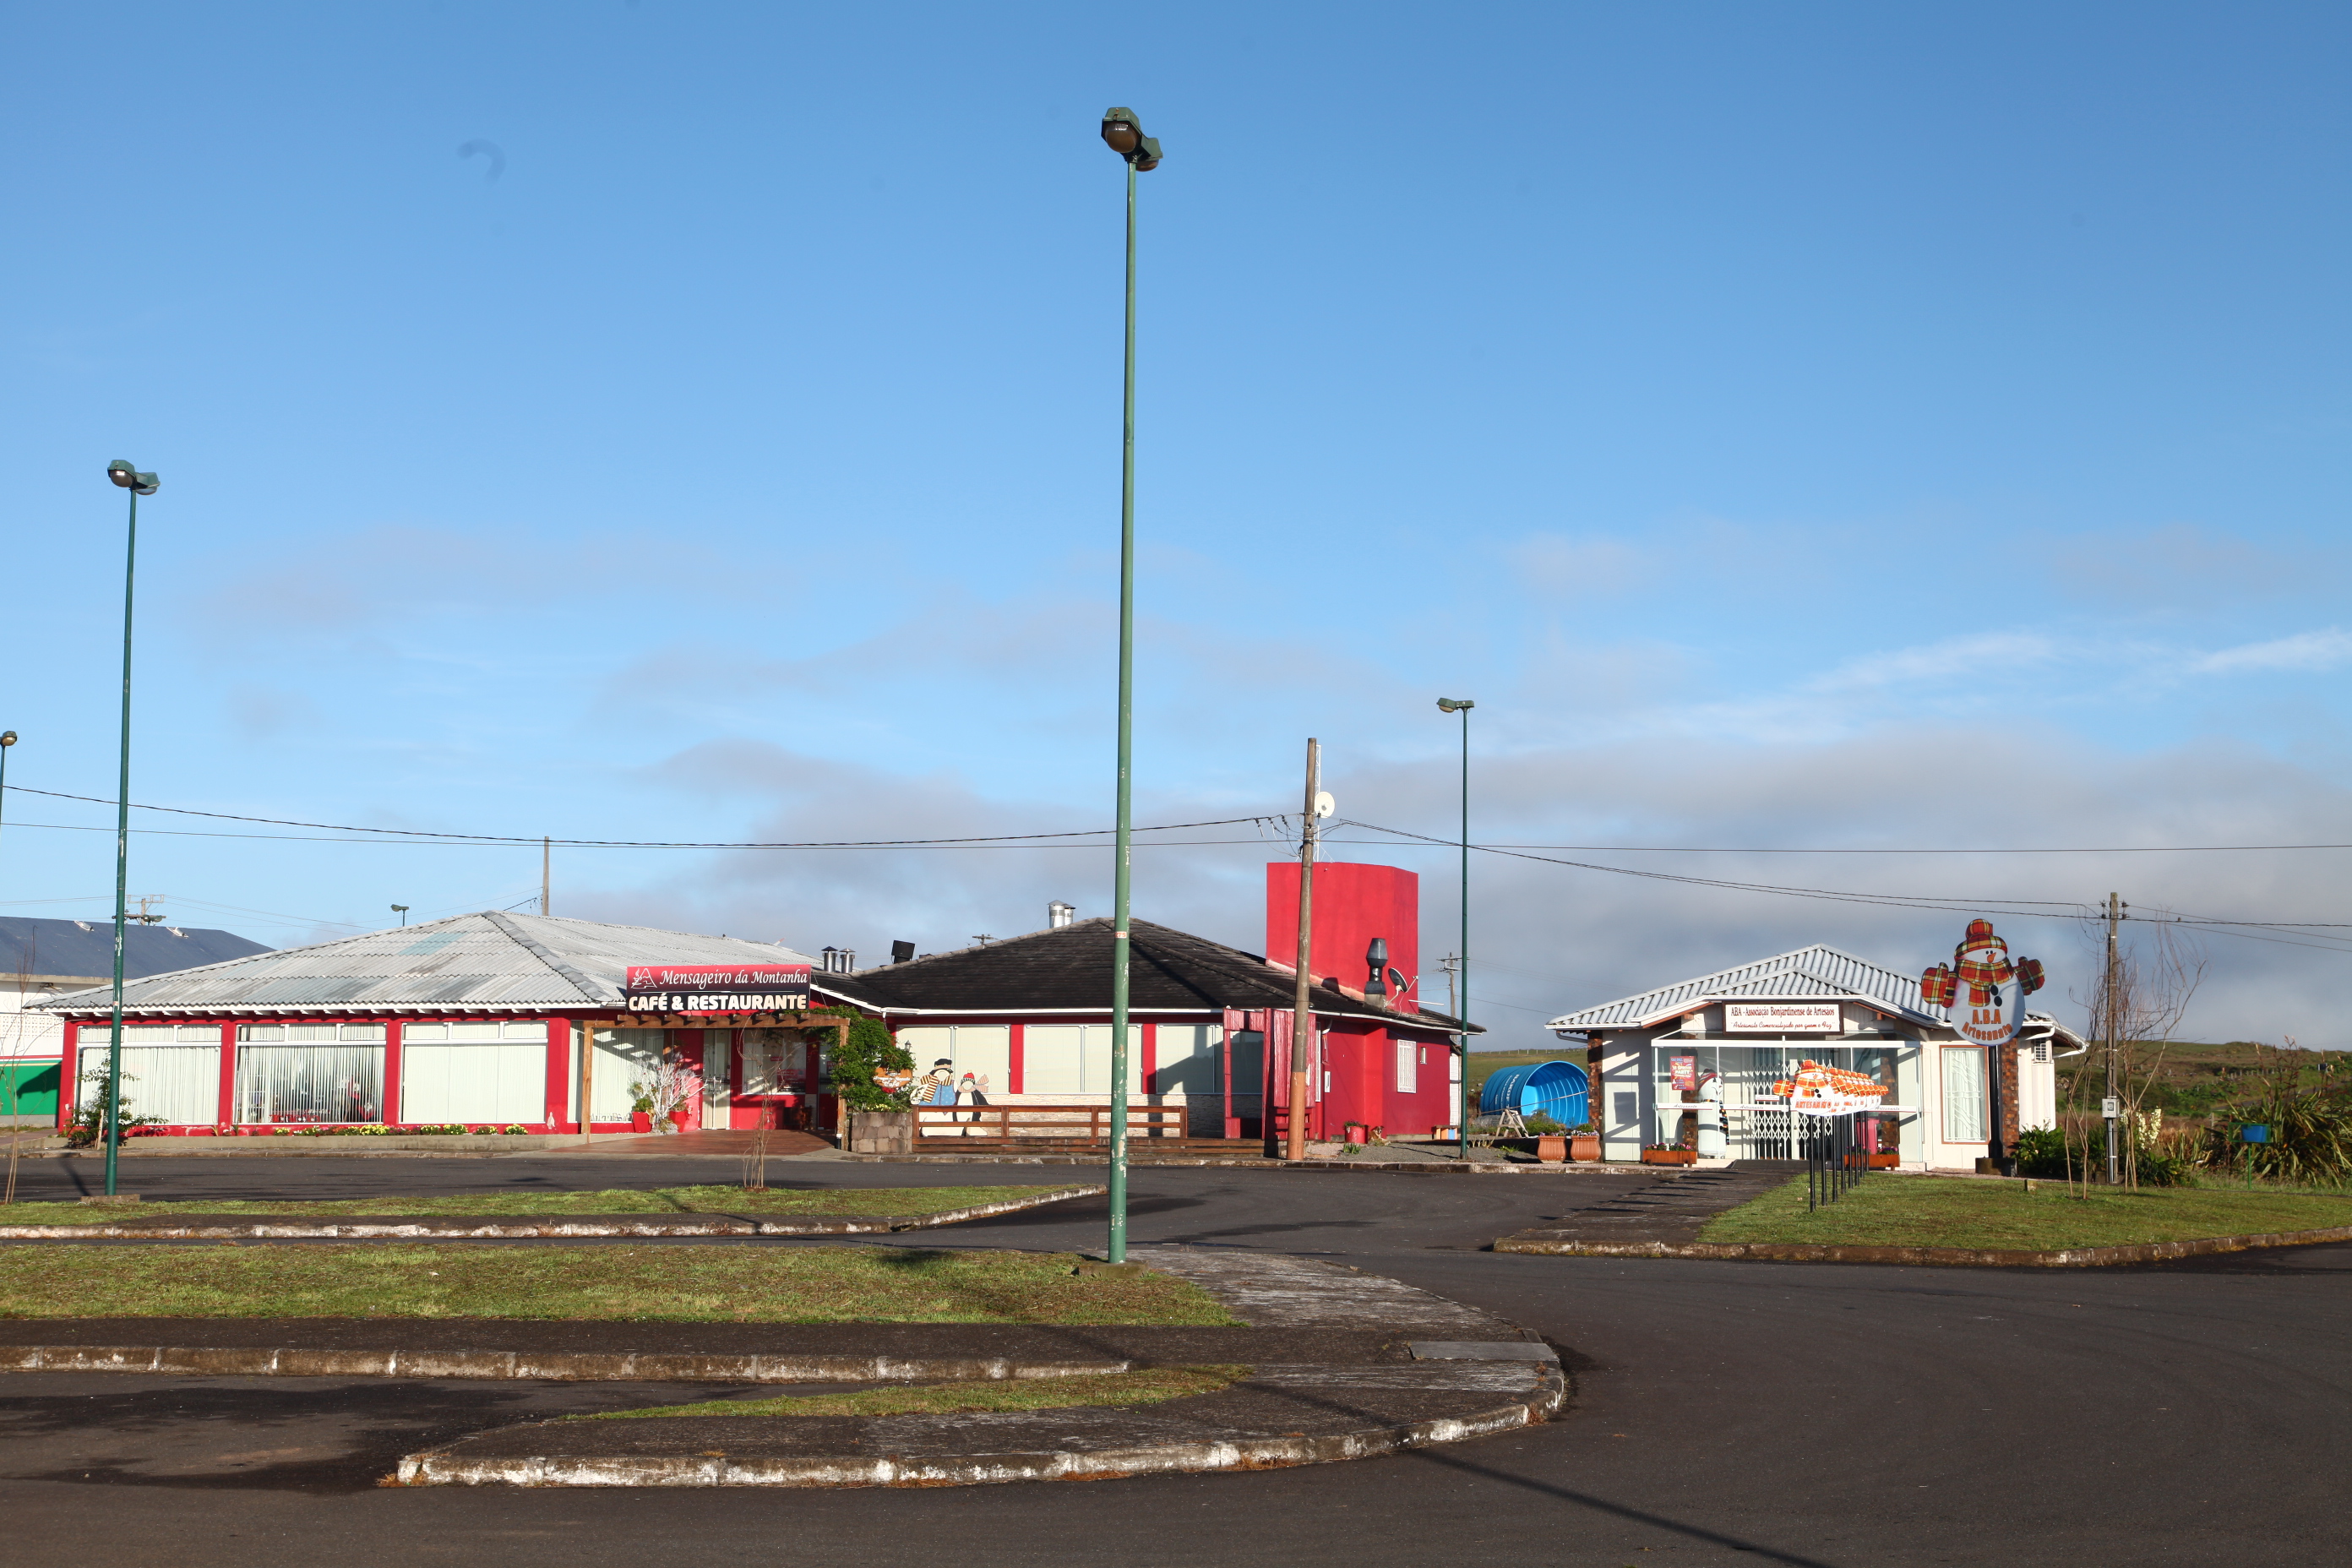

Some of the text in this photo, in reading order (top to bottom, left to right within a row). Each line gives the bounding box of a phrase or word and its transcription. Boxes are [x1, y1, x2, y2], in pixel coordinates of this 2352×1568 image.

[660, 969, 808, 989] Mensageiro da Montanha
[629, 993, 807, 1011] CAFÉ & RESTAURANTE
[1731, 1006, 1742, 1015] ABA
[1745, 1006, 1769, 1018] Associação
[1771, 1006, 1805, 1018] Bonjardinense
[1806, 1006, 1813, 1015] de
[1814, 1006, 1835, 1015] Artesãos
[1972, 1009, 2001, 1025] A.B.A
[1962, 1021, 2012, 1041] Artesanato
[1795, 1100, 1832, 1108] ARTESANATO
